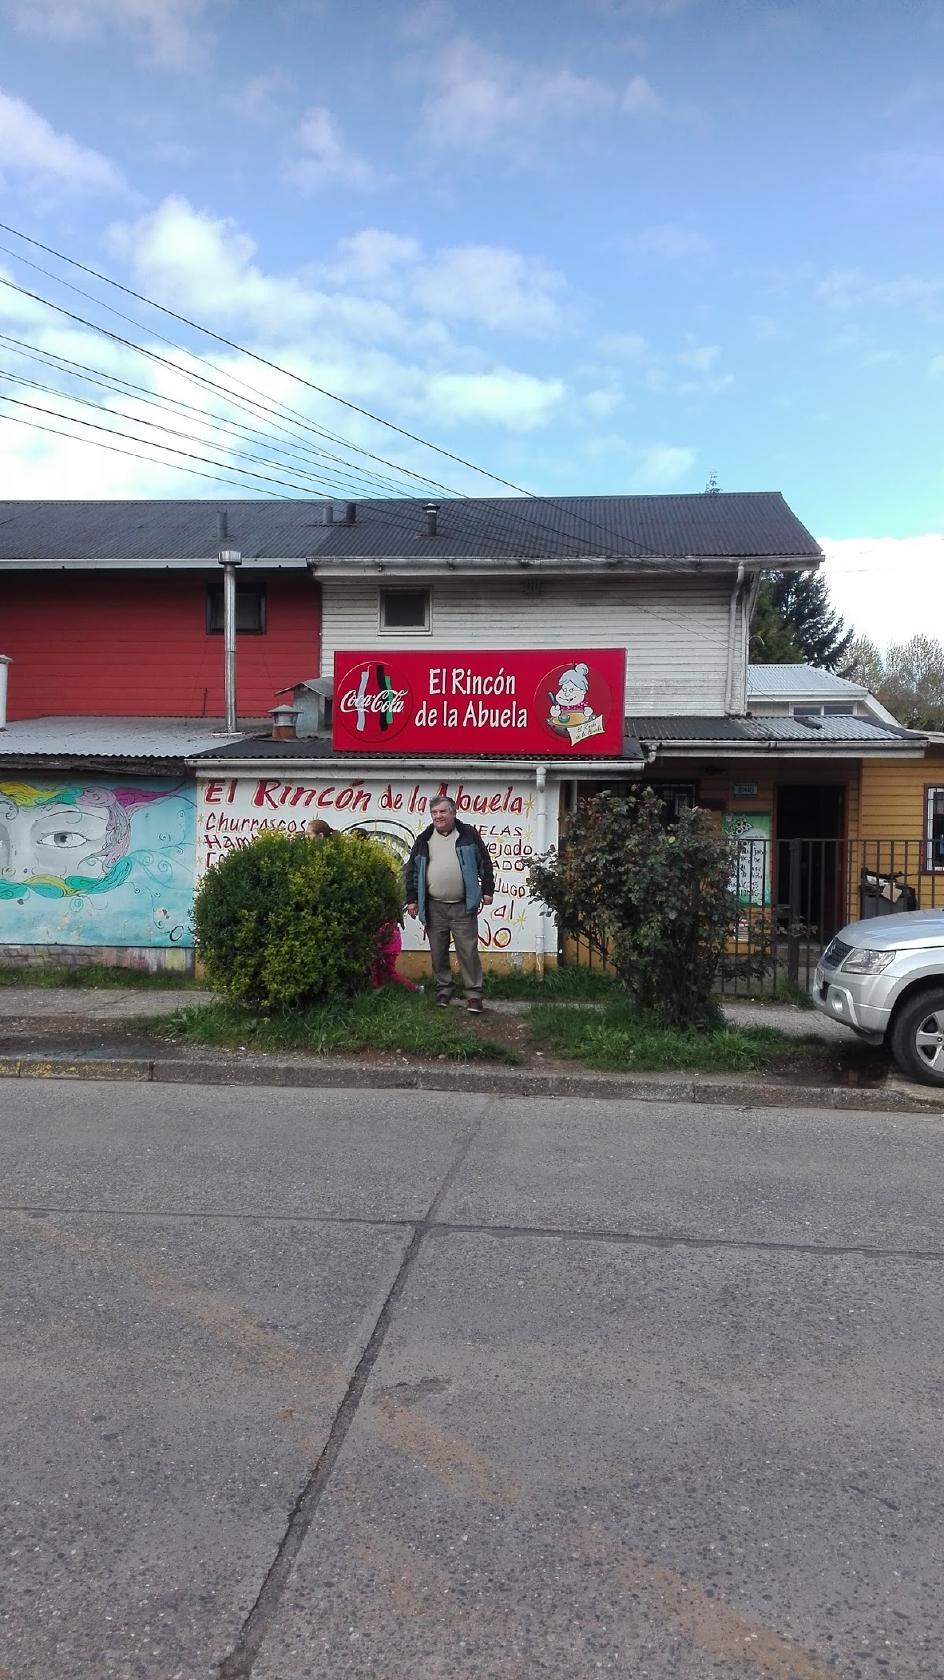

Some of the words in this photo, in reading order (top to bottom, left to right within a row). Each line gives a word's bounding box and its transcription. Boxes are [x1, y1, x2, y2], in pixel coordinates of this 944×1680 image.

[429, 667, 447, 695] El
[451, 667, 516, 696] Rincón
[414, 700, 438, 727] de
[443, 700, 458, 728] la
[462, 700, 528, 728] Abuela
[205, 778, 238, 803] El
[253, 779, 372, 811] Rincón
[380, 784, 403, 809] de
[409, 784, 427, 813] la
[206, 812, 307, 833] Churrascos
